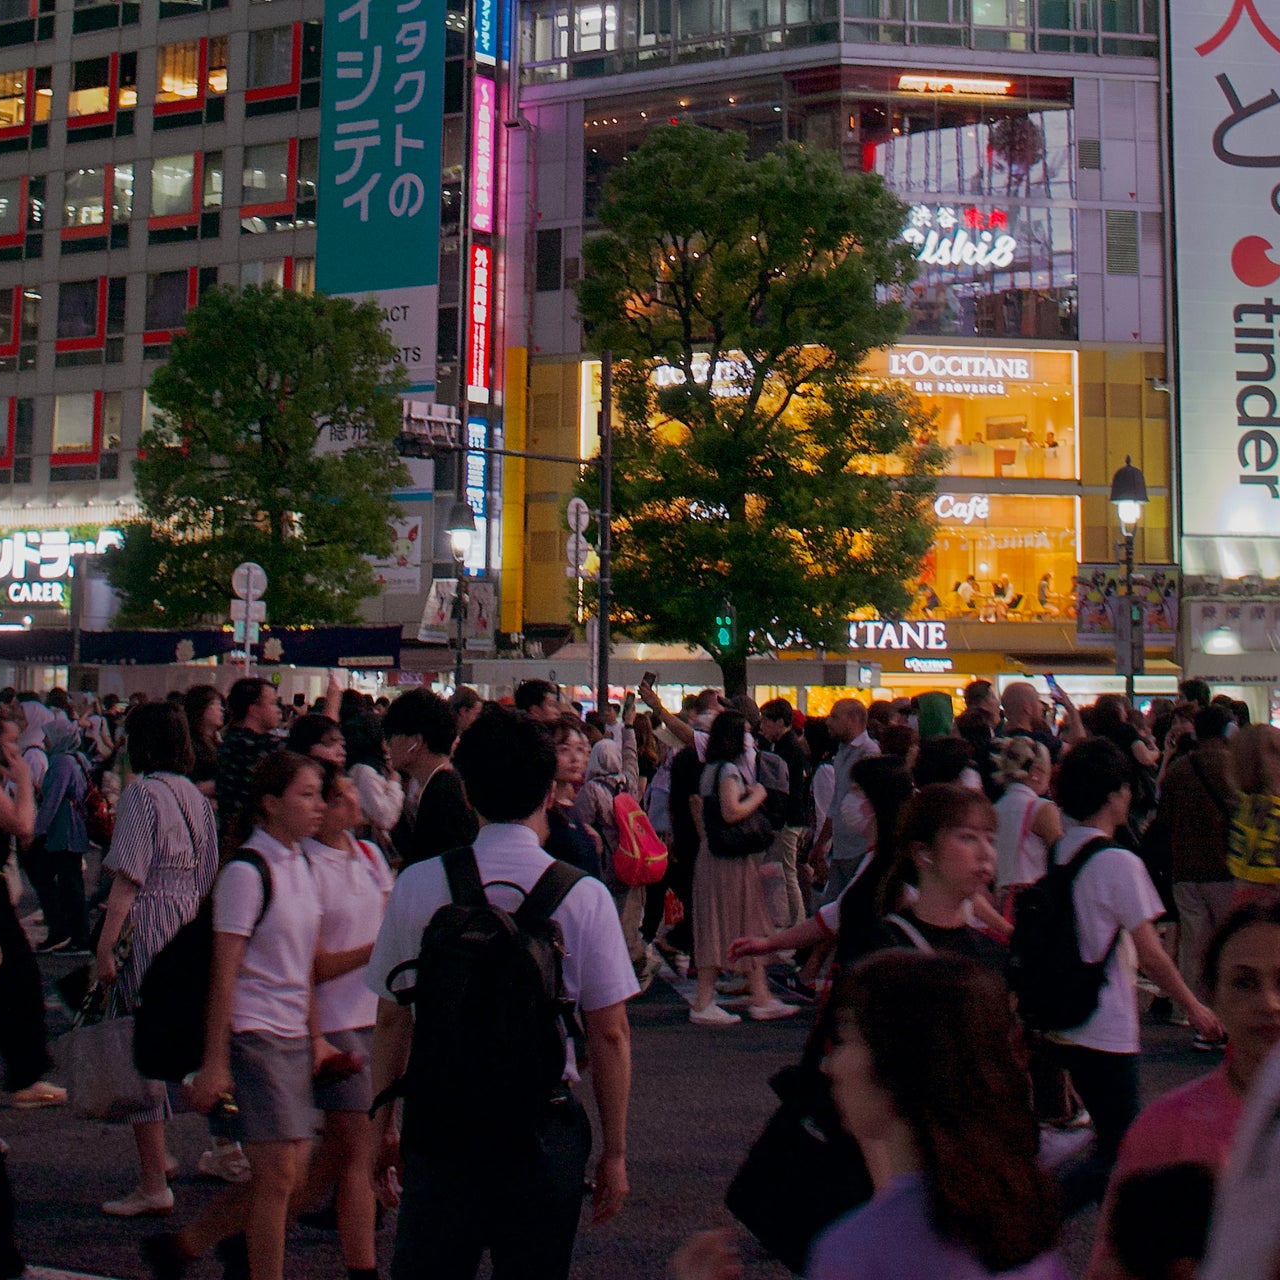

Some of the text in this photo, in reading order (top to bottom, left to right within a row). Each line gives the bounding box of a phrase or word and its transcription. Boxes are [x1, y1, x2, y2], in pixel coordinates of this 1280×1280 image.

[910, 205, 958, 229] 渋谷
[890, 350, 1029, 379] L'OCCITANE
[916, 381, 1005, 395] EN PROVENCE
[934, 493, 989, 525] Café
[7, 581, 66, 603] CARER
